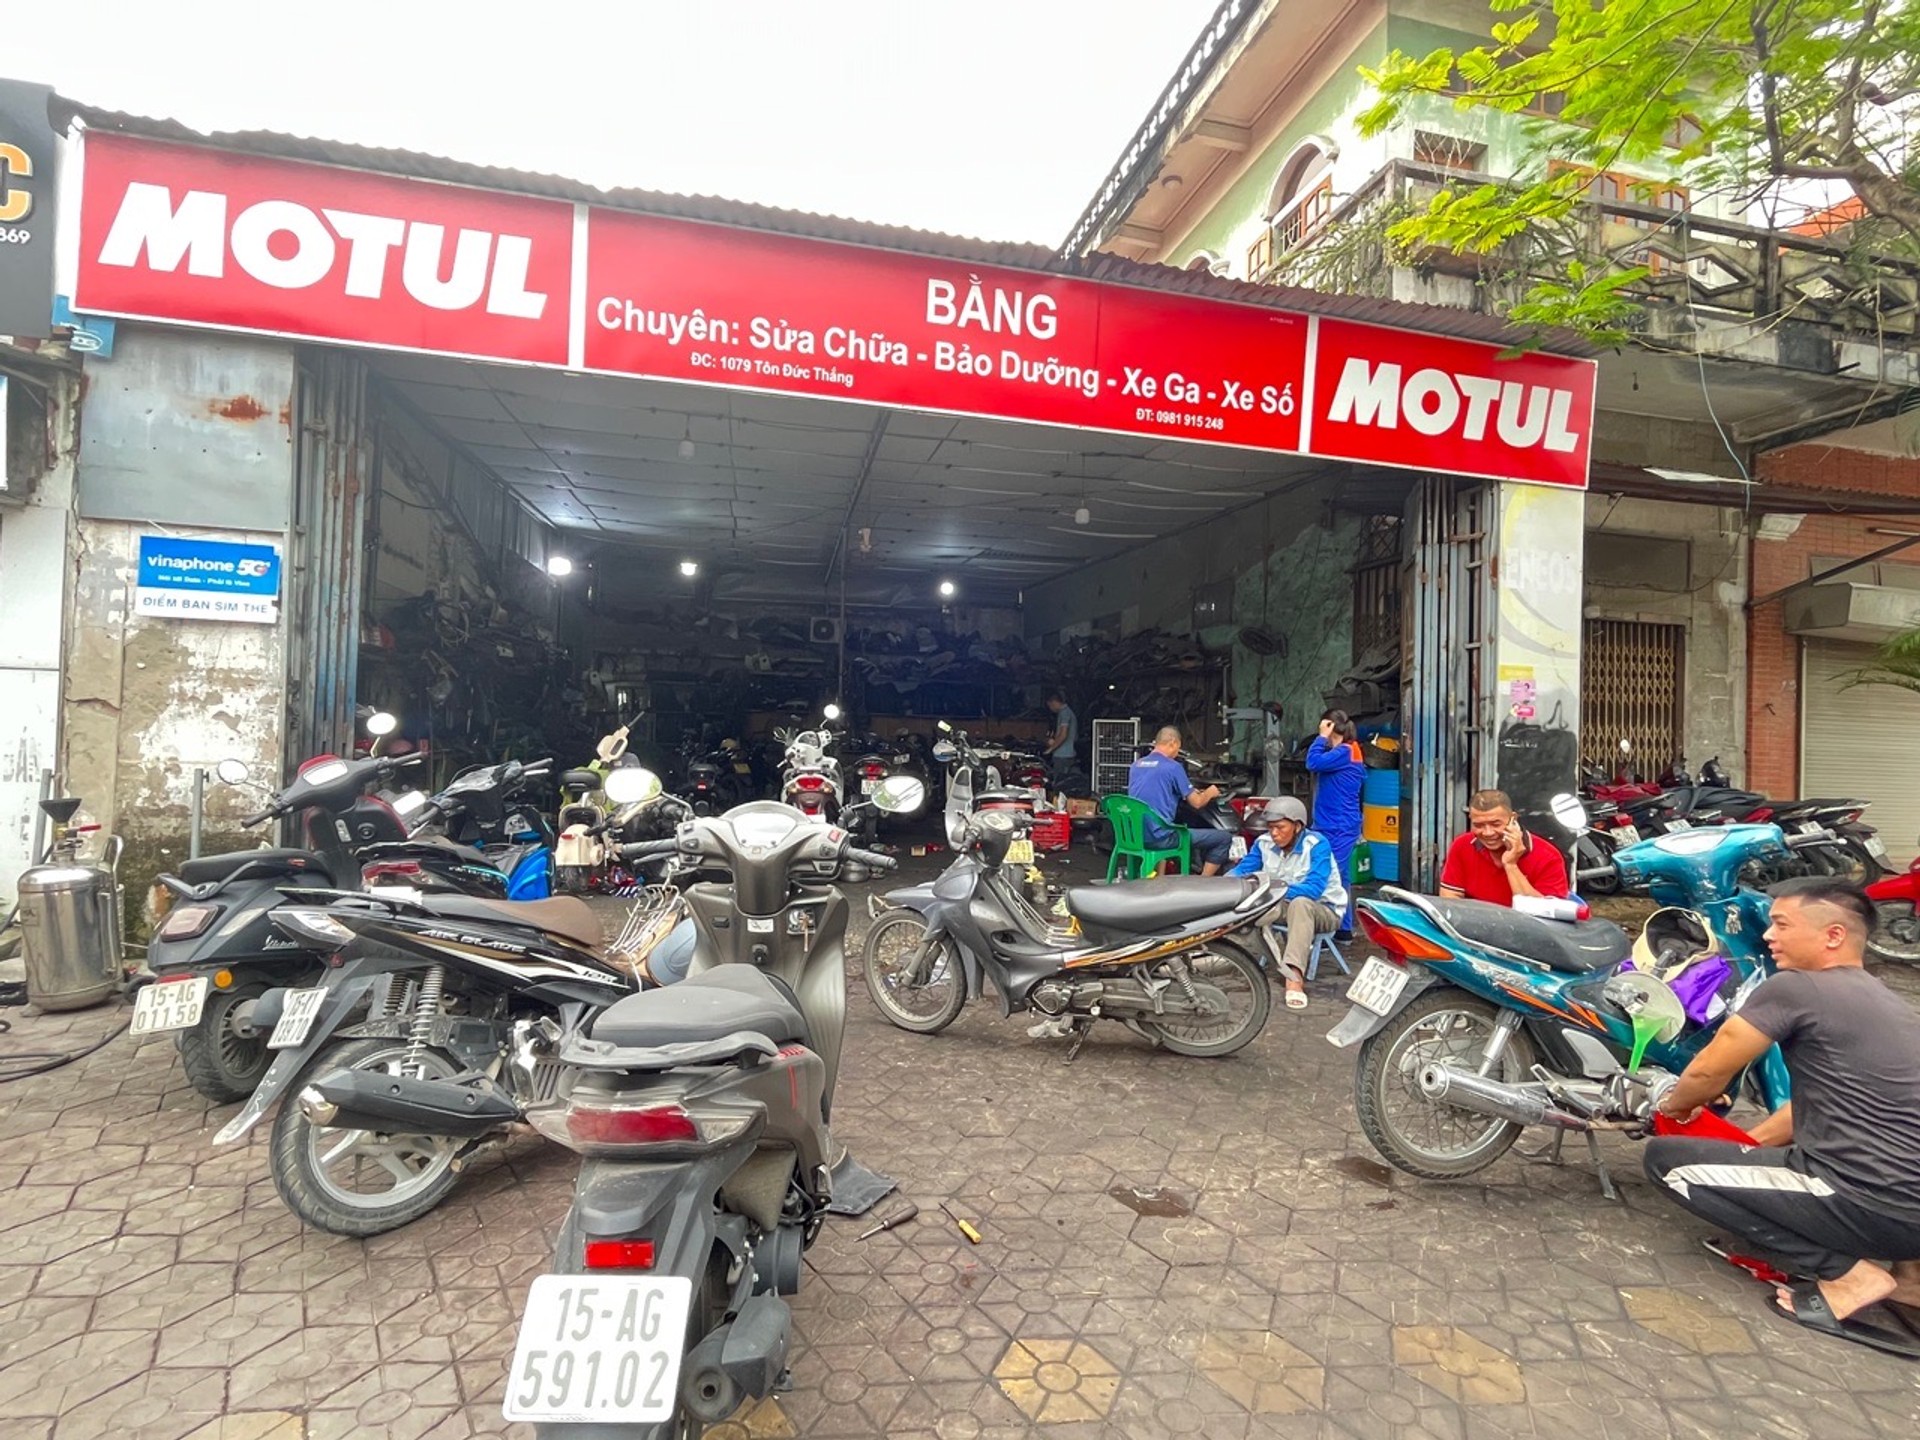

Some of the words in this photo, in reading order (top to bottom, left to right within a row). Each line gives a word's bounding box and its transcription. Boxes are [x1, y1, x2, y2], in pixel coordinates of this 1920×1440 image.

[97, 181, 548, 319] MOTUL
[926, 272, 1057, 340] BẰNG
[597, 296, 740, 346] Chuyên:
[749, 317, 815, 354] Sửa
[823, 327, 909, 366] Chữa
[934, 340, 992, 377] Bảo
[1000, 349, 1099, 398] Dưỡng
[1121, 366, 1157, 398] Xe
[1164, 373, 1200, 404] Ga
[1221, 380, 1254, 411] Xe
[1260, 383, 1294, 416] Số
[690, 351, 716, 368] ĐC:
[719, 356, 752, 373] 1079
[753, 359, 780, 376] Tôn
[781, 362, 811, 380] Đức
[812, 366, 854, 388] Thắng
[1136, 407, 1155, 421] ĐT:
[1156, 410, 1182, 425] 0981
[1183, 414, 1203, 428] 915
[1204, 417, 1224, 430] 248
[1327, 357, 1579, 453] MOTUL
[147, 554, 235, 573] vinaphone
[215, 601, 238, 612] SIM
[136, 1003, 199, 1031] 011.58
[150, 982, 196, 1009] 15-AG
[555, 1288, 665, 1342] 15-AG
[517, 1349, 670, 1409] 591.02
